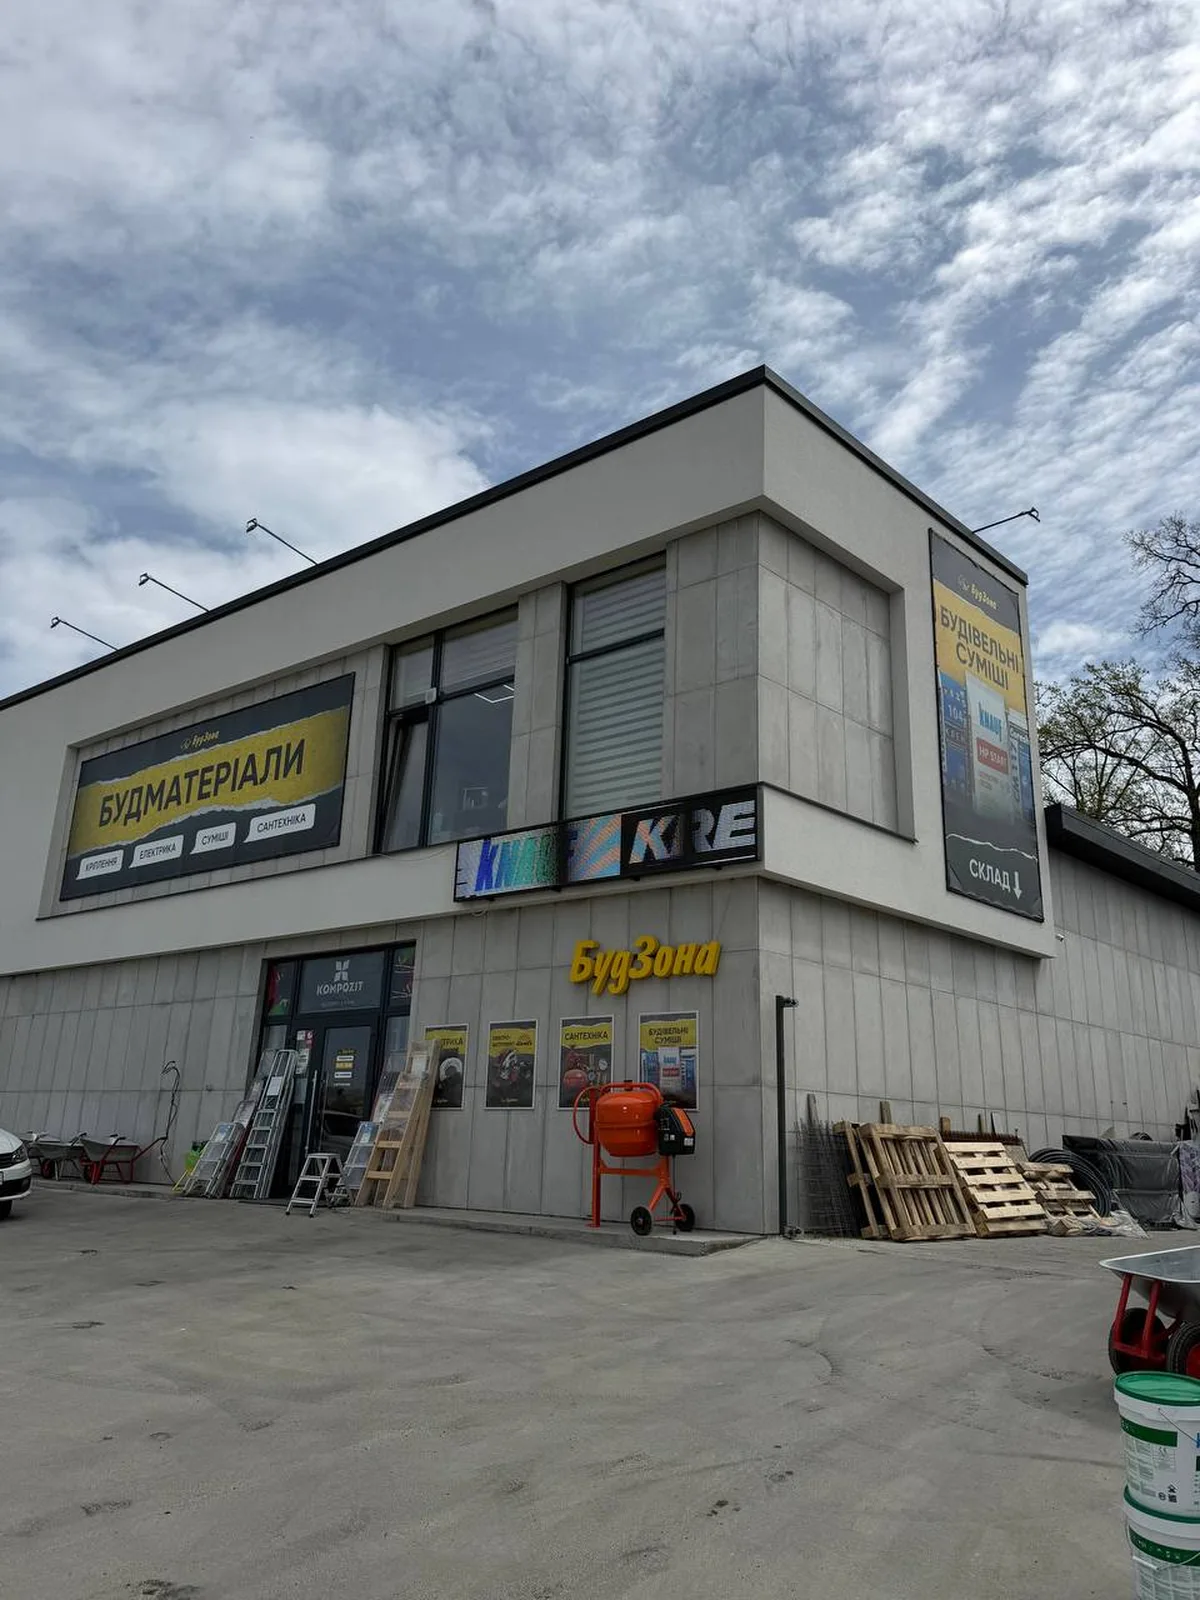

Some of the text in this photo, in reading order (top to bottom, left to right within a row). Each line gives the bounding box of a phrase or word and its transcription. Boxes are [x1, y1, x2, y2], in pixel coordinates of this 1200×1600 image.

[940, 605, 1018, 673] БУДІВЕЛЬНІ
[956, 642, 1009, 690] СУМІШІ
[99, 738, 305, 828] БУДМАТЕРІАЛИ
[257, 813, 306, 833] САНТЕХНІКА
[201, 830, 229, 846] СУМІШІ
[139, 842, 177, 860] ЕЛЕКТРИКА
[969, 858, 1011, 893] СКЛАД
[569, 935, 721, 996] БудЗона
[316, 980, 364, 997] KOMPOZIT
[440, 1036, 464, 1047] ТРИКА
[564, 1030, 609, 1042] САНТЕХНІКА
